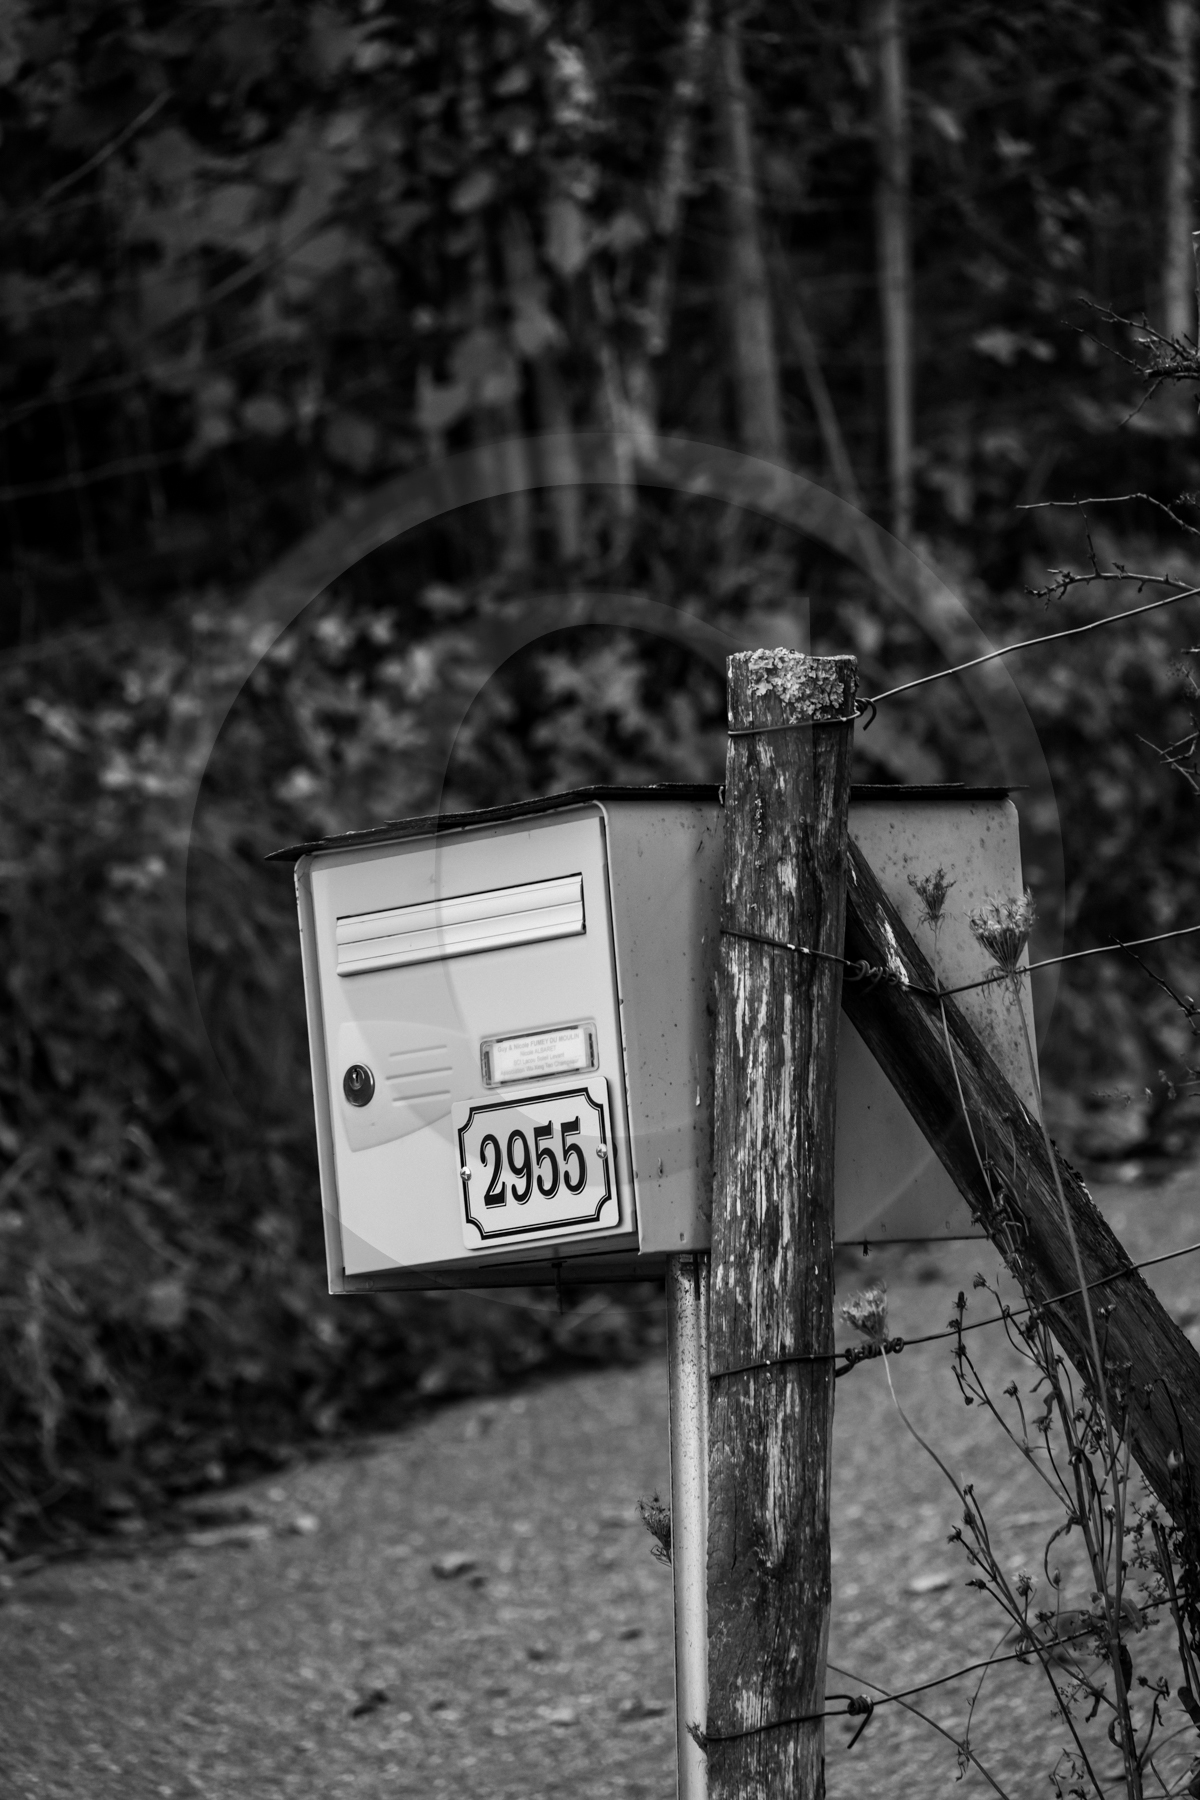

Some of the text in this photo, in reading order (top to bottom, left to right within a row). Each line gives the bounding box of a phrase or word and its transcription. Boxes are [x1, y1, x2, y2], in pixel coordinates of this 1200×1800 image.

[514, 1042, 529, 1050] Nicole
[530, 1038, 548, 1046] FUMEY
[559, 1033, 580, 1042] MOULIN
[535, 1045, 556, 1054] ALBARET
[479, 1115, 588, 1210] 2955
